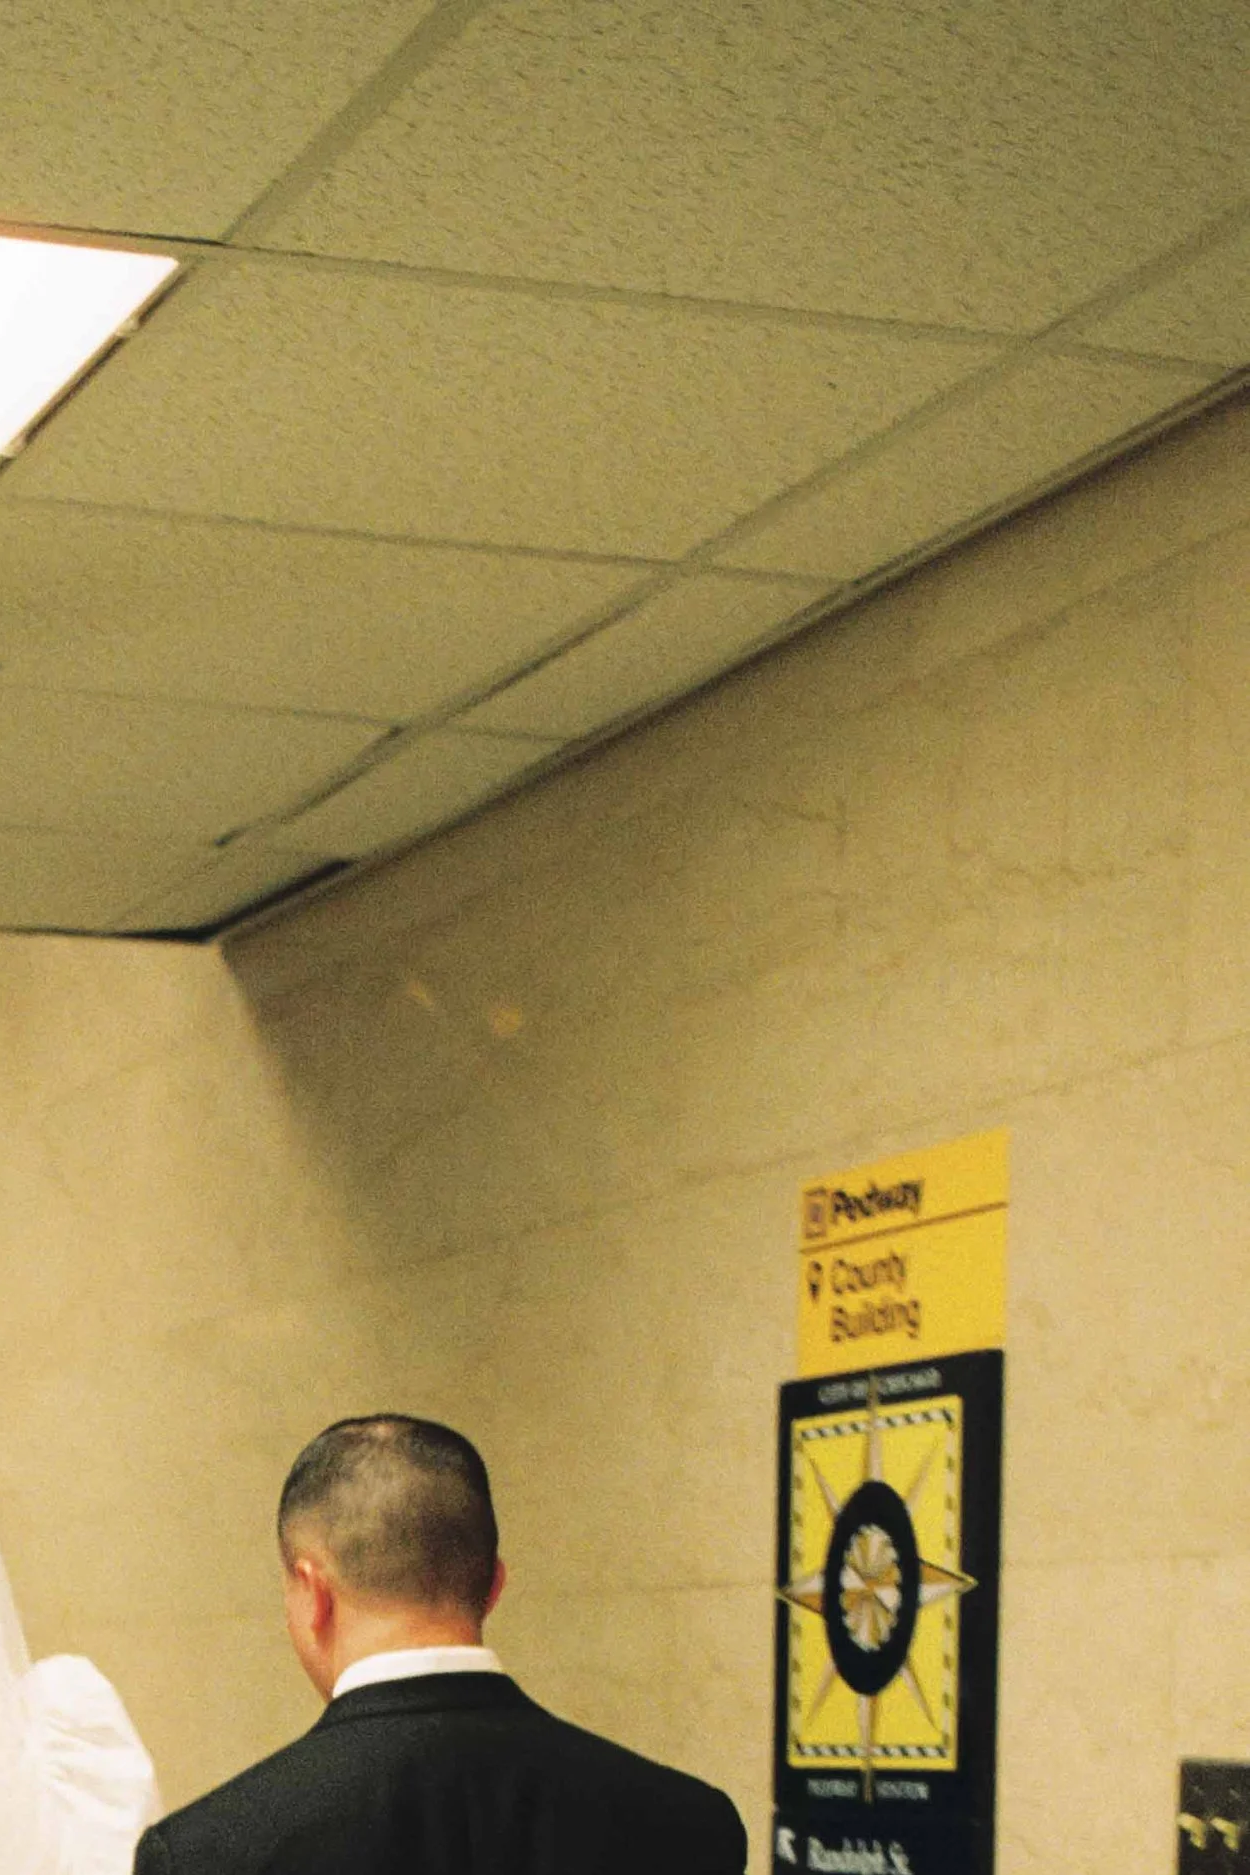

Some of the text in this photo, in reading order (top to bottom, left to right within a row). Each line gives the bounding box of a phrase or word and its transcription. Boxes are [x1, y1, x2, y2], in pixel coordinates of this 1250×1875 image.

[830, 1179, 923, 1223] Pedway
[829, 1251, 907, 1294] County
[830, 1299, 920, 1343] Building
